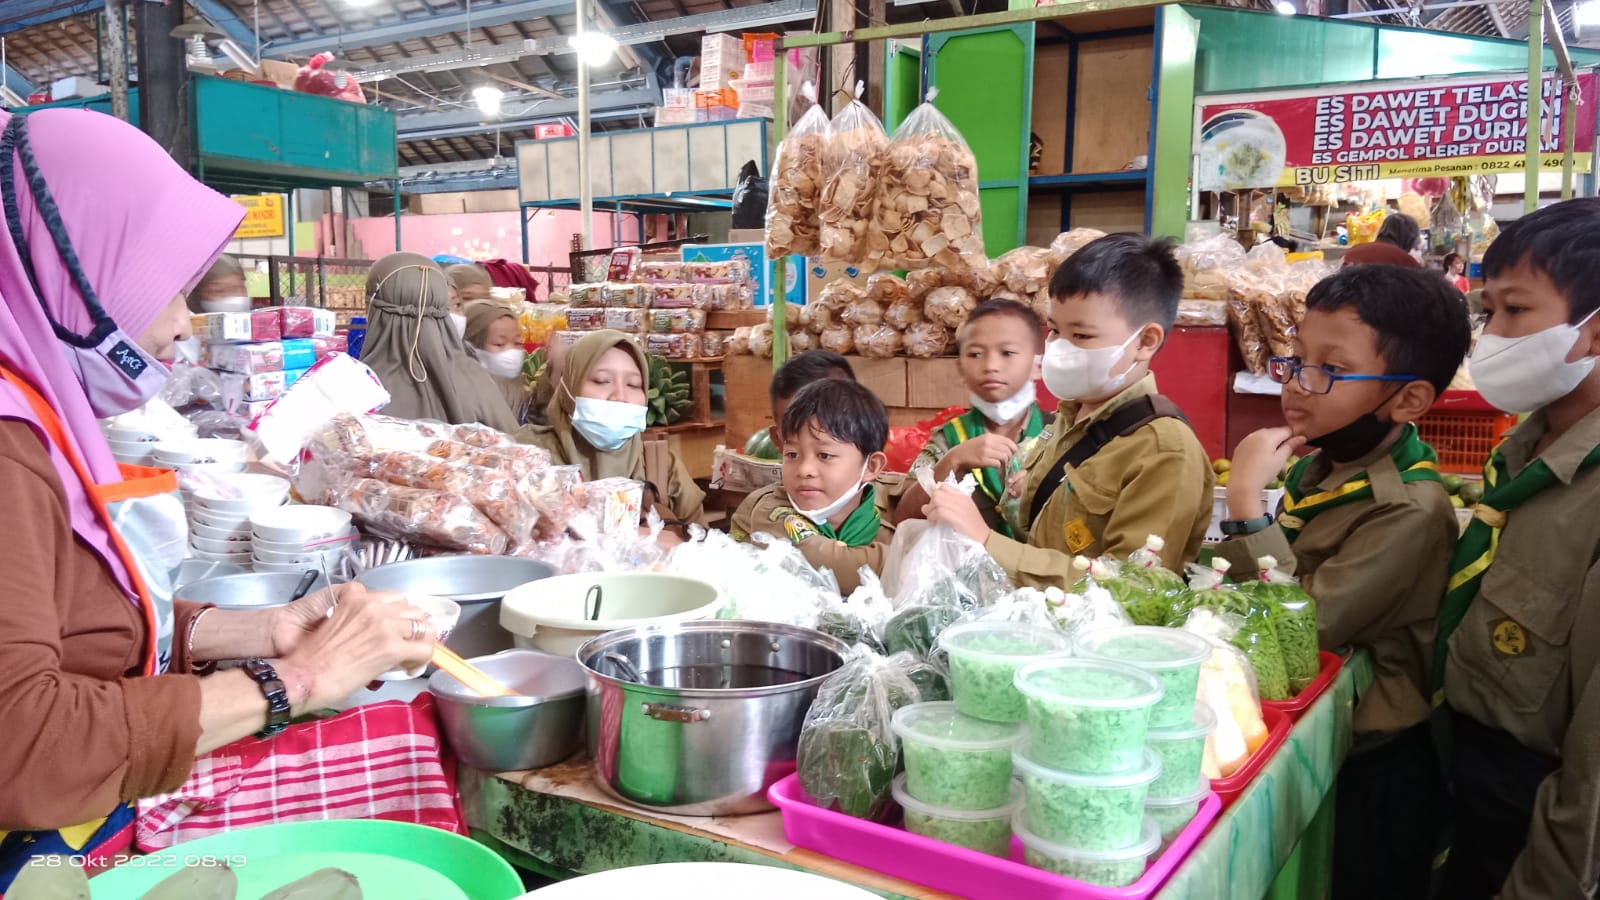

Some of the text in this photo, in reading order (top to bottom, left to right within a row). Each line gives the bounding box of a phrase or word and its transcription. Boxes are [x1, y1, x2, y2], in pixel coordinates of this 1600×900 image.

[1315, 79, 1562, 115] ES DAWET TELASH
[1314, 114, 1345, 133] ES
[1352, 106, 1451, 131] DAWET
[1311, 137, 1559, 164] ES GEMPOL PLERET DURN
[1313, 132, 1343, 151] ES
[1349, 126, 1447, 149] DAWET
[1295, 164, 1380, 185] BU SITI
[1434, 164, 1473, 172] Pesanan
[1481, 161, 1510, 170] 0822
